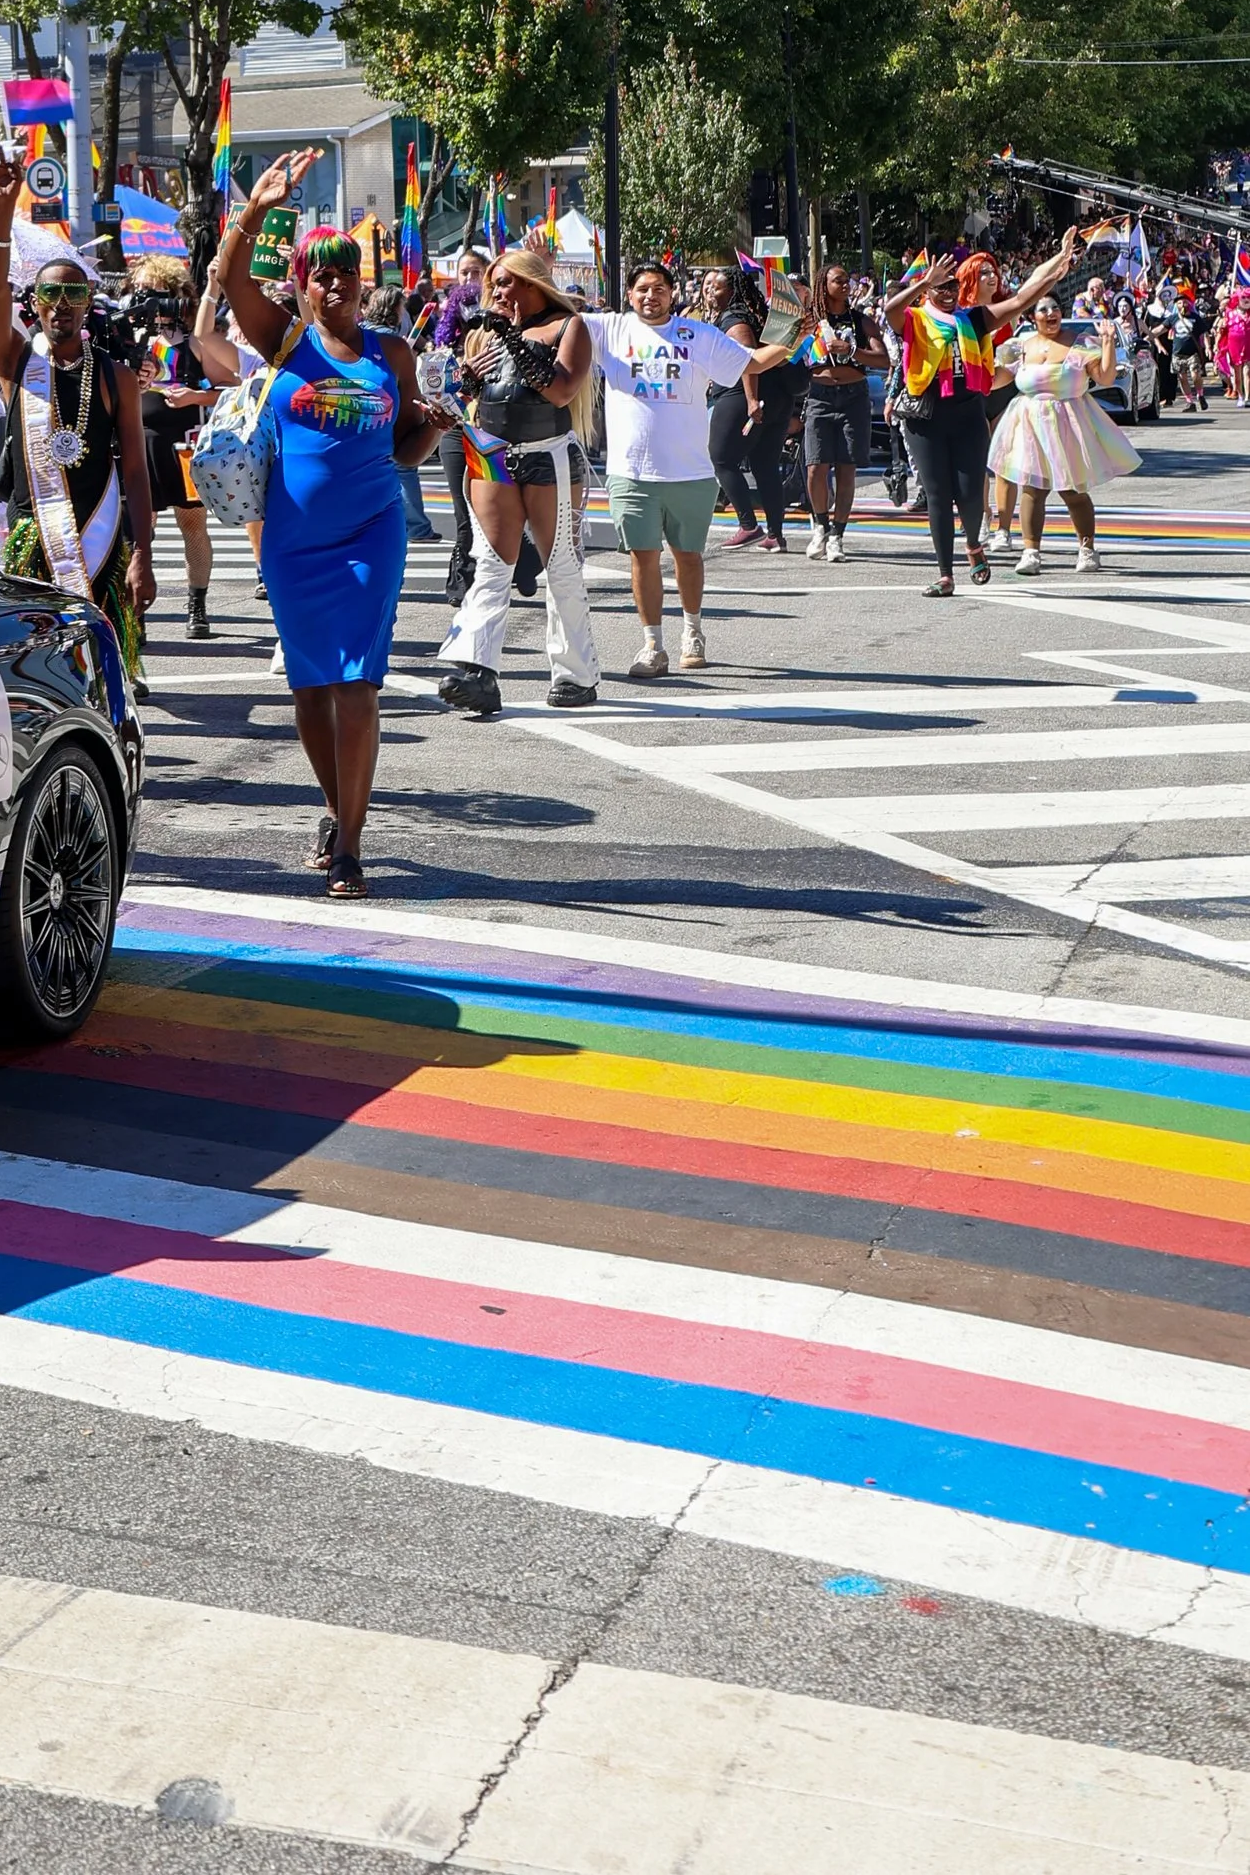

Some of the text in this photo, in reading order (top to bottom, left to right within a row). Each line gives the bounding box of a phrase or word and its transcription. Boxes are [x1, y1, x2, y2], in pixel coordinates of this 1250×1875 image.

[141, 233, 186, 248] Bull
[254, 253, 284, 266] LARGE
[625, 344, 689, 361] JUAN
[632, 382, 678, 400] ATL
